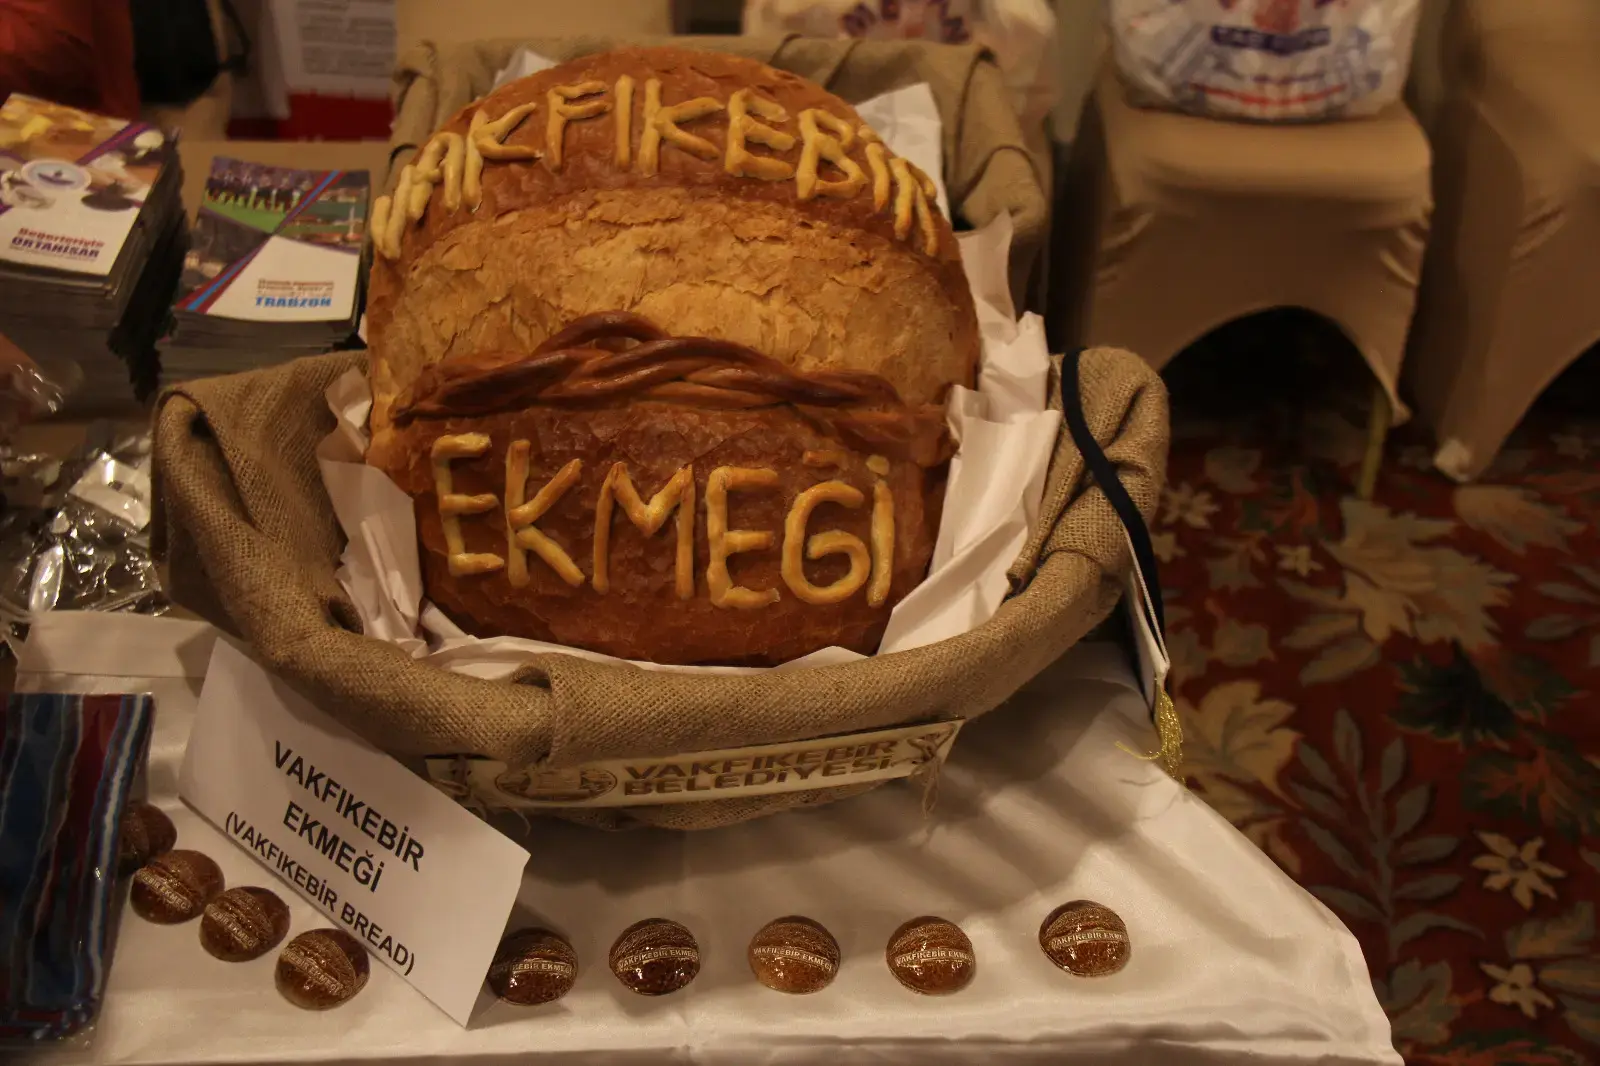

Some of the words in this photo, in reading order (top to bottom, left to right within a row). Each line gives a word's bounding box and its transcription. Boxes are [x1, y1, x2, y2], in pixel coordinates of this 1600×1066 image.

[255, 296, 332, 307] TRABZON
[624, 740, 898, 780] VAKFIKEBİR
[624, 756, 892, 796] BELEDİYESİ
[273, 740, 425, 872] VAKFIKEBİR
[283, 801, 385, 893] EKMEĞİ
[225, 811, 339, 913] (VAKFIKEBİR
[340, 902, 416, 976] BREAD)
